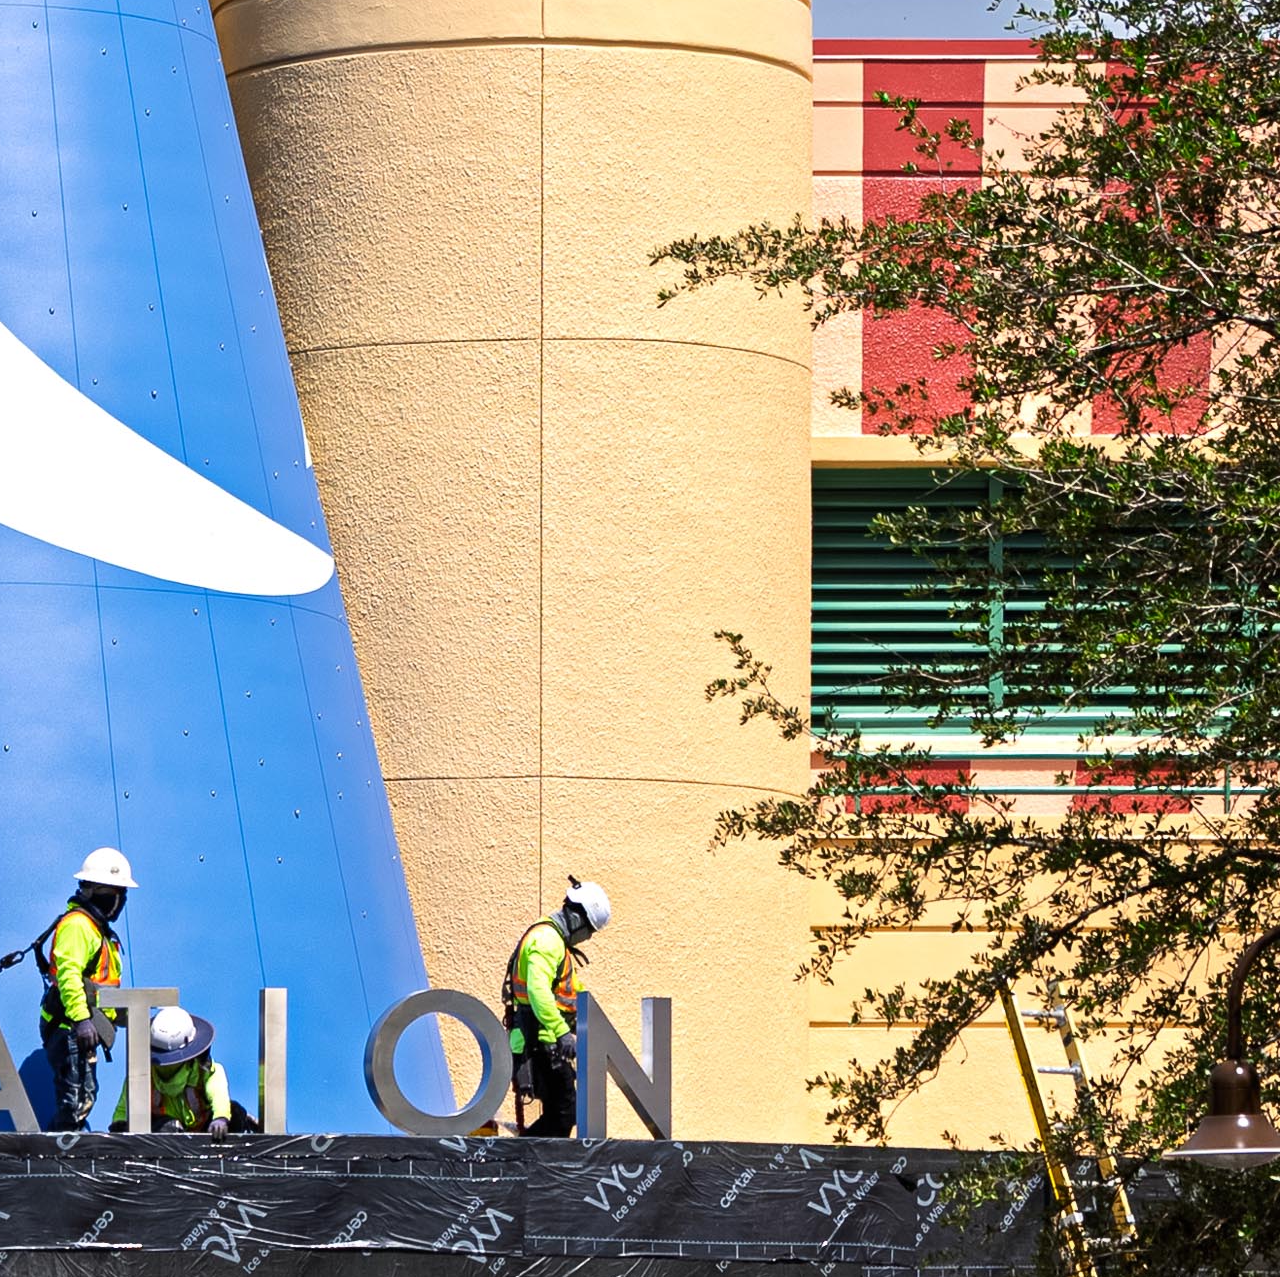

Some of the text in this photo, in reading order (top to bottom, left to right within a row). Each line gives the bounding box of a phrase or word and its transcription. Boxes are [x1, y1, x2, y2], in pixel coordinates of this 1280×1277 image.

[611, 1164, 664, 1222] Ice & Water
[832, 1209, 850, 1227] Ice
[851, 1171, 881, 1202] Water
[242, 1256, 261, 1275] Ice
[488, 1257, 506, 1275] Ice
